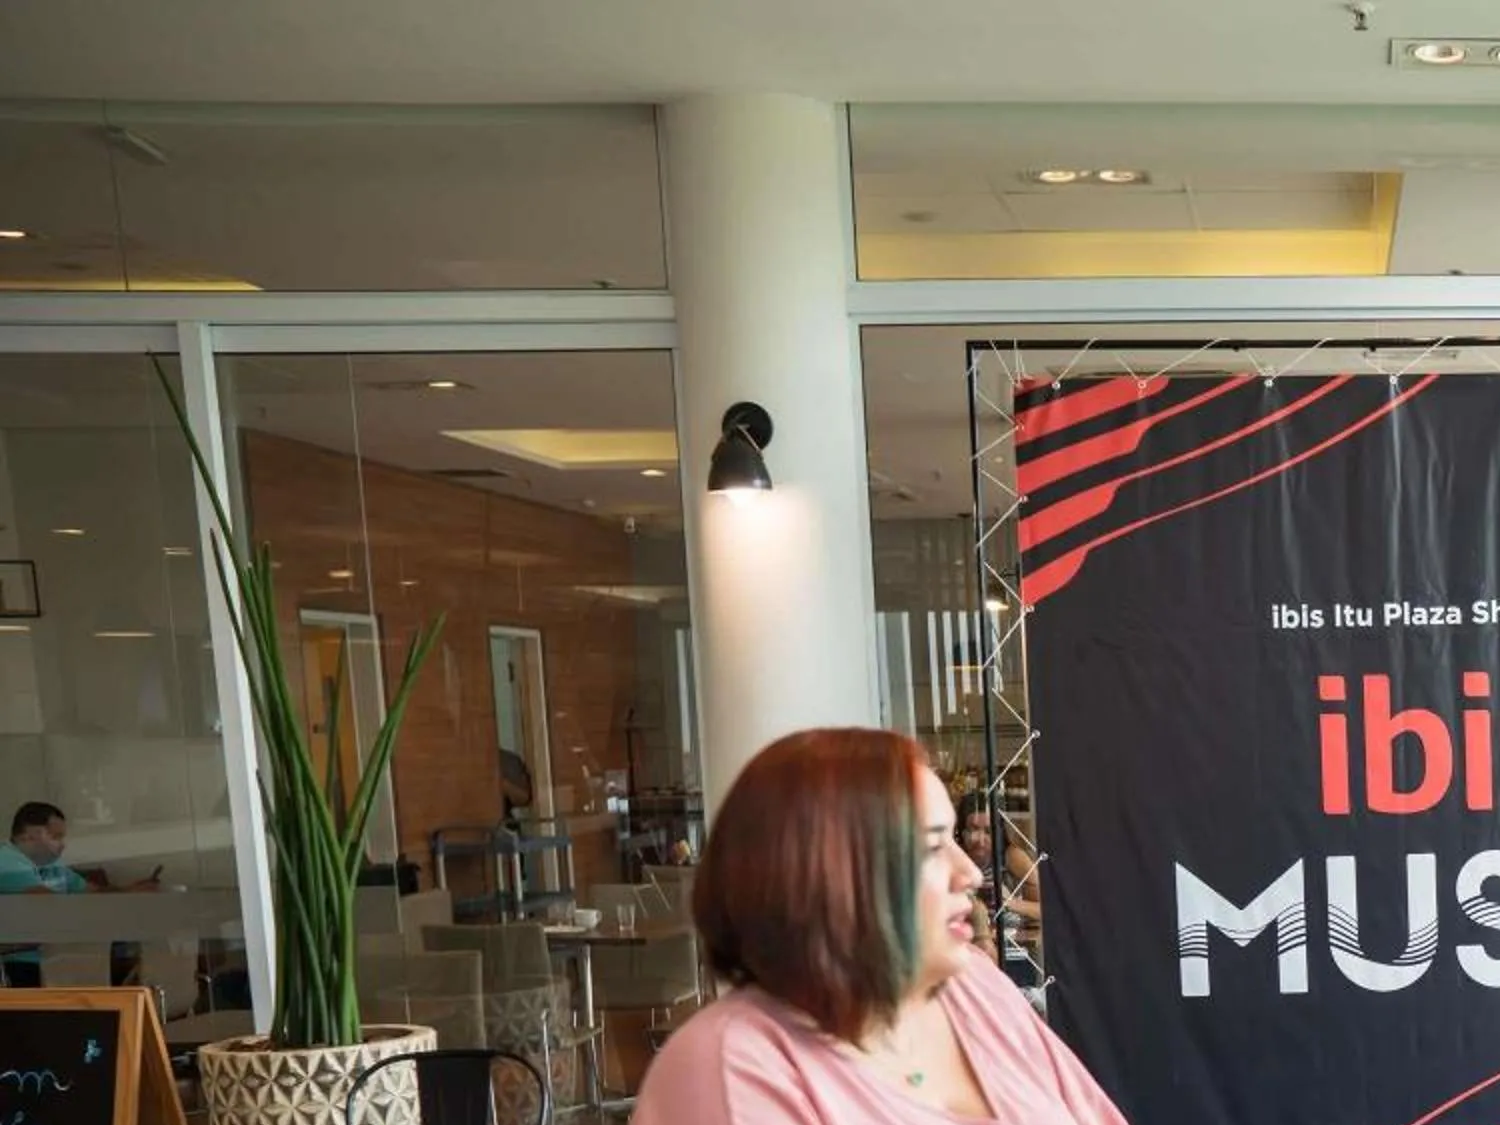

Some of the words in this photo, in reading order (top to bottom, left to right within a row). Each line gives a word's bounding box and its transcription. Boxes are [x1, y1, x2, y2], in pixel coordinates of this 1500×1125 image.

[1271, 603, 1325, 629] ibis
[1334, 603, 1373, 628] Itu
[1383, 601, 1462, 627] Plaza
